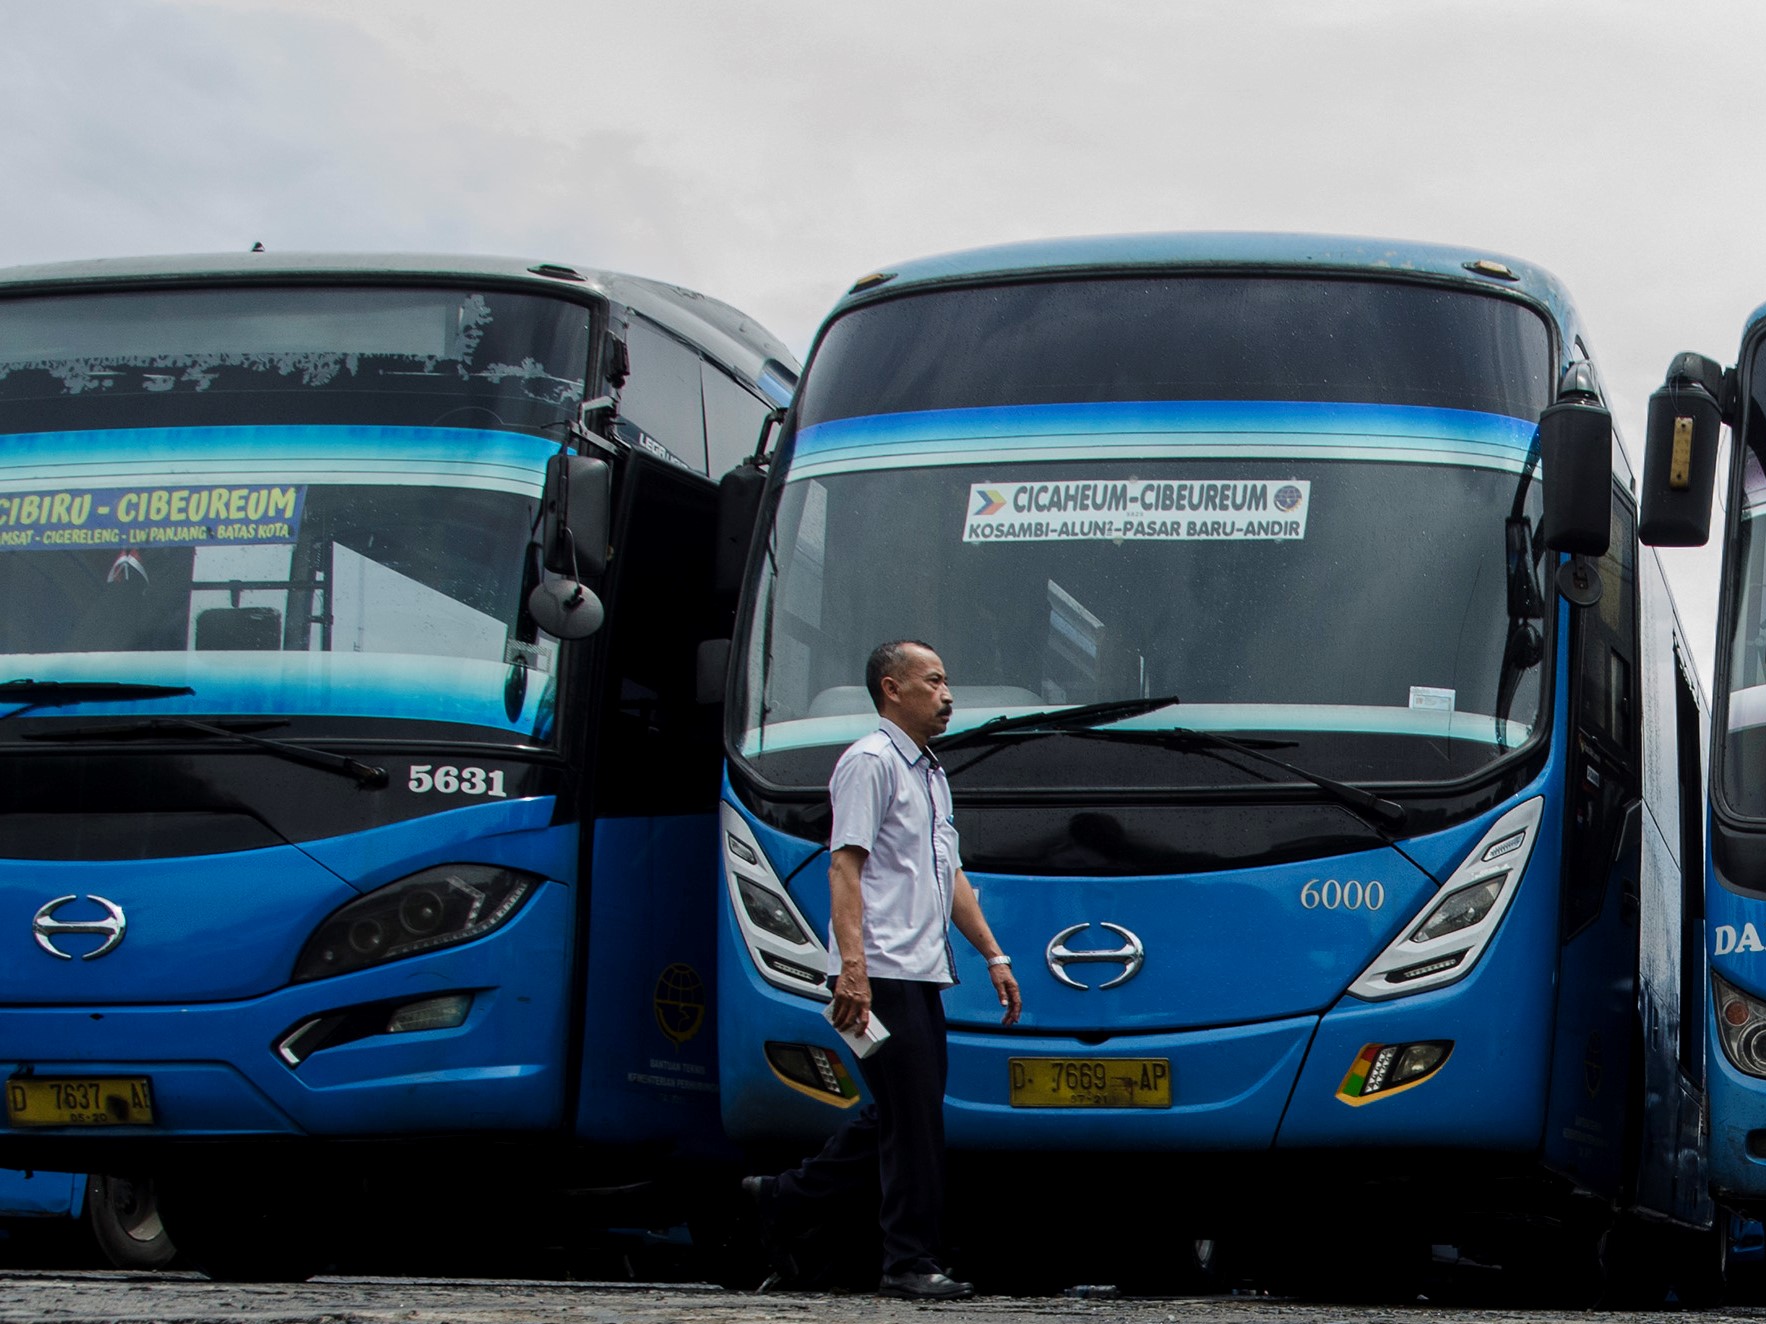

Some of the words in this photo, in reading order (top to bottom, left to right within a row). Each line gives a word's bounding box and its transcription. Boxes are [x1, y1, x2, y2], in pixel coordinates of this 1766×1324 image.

[117, 487, 296, 523] CIBEUREUM
[1013, 483, 1268, 513] CICAHEUM-CIBEUREUM
[42, 529, 120, 544] CIGERELENG
[150, 526, 207, 542] PANJANG
[217, 524, 256, 539] BATAS
[258, 523, 290, 538] KOTA
[1186, 520, 1300, 538] BARU-ANDIR
[408, 764, 507, 797] 5631
[1301, 879, 1385, 910] 6000
[1012, 1062, 1026, 1089] D
[1051, 1062, 1107, 1091] 7669
[1140, 1063, 1166, 1090] AP
[12, 1085, 27, 1111] D
[50, 1083, 101, 1110] 7637
